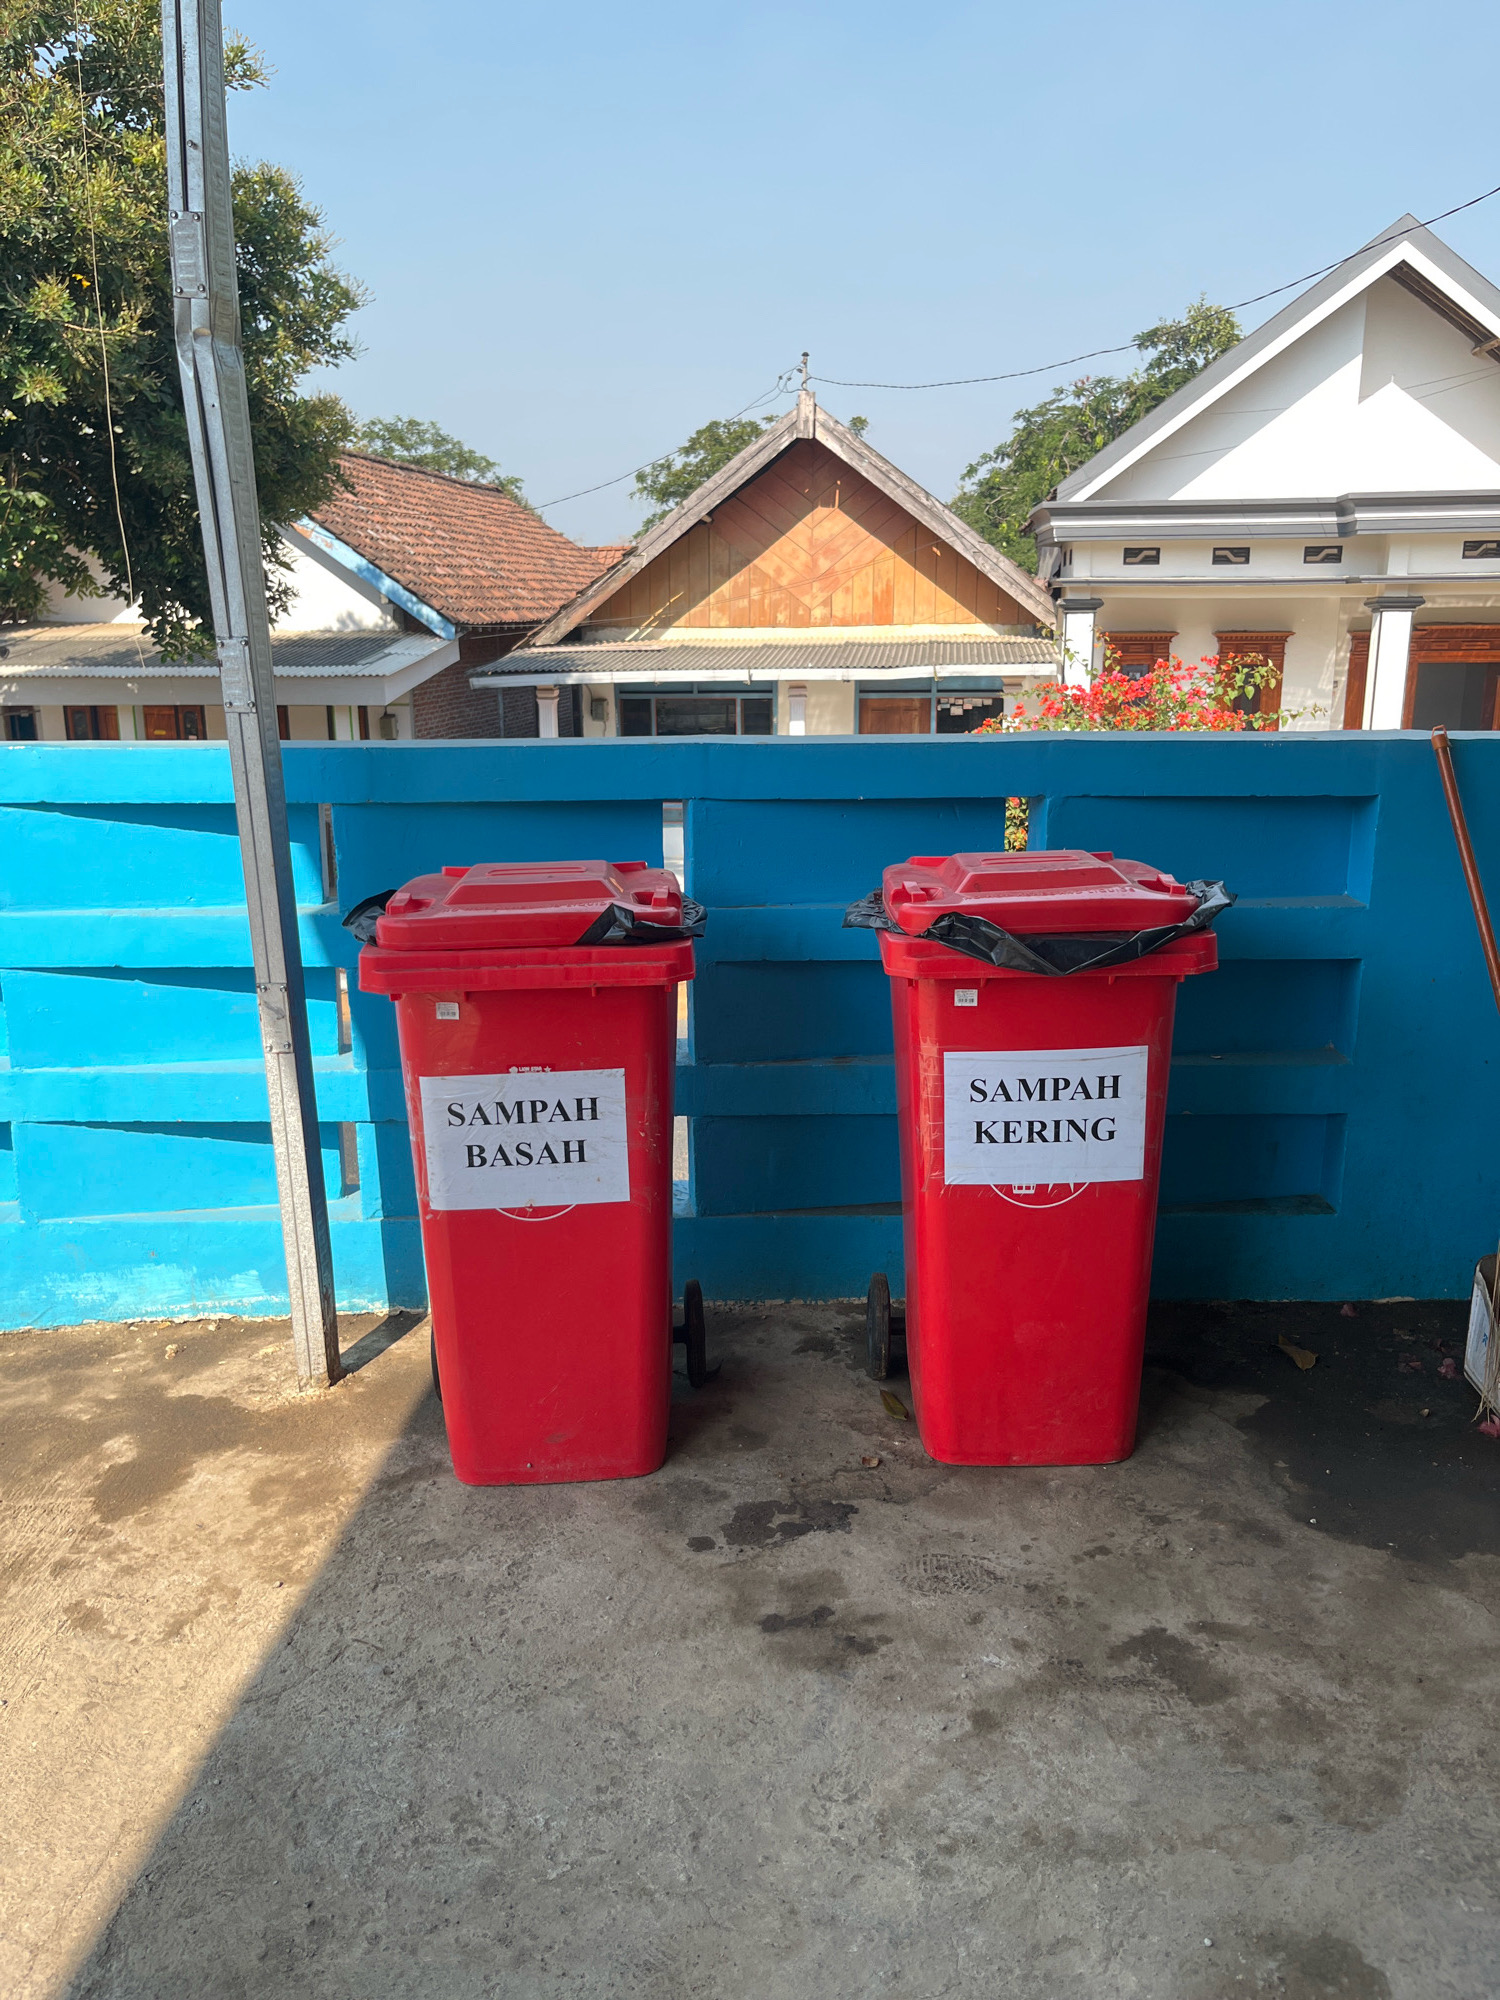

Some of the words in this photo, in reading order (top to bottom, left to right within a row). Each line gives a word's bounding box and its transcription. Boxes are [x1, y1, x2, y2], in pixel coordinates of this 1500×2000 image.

[970, 1074, 1122, 1103] SAMPAH
[447, 1096, 600, 1127] SAMPAH
[974, 1117, 1118, 1144] KERING
[465, 1139, 588, 1168] BASAH
